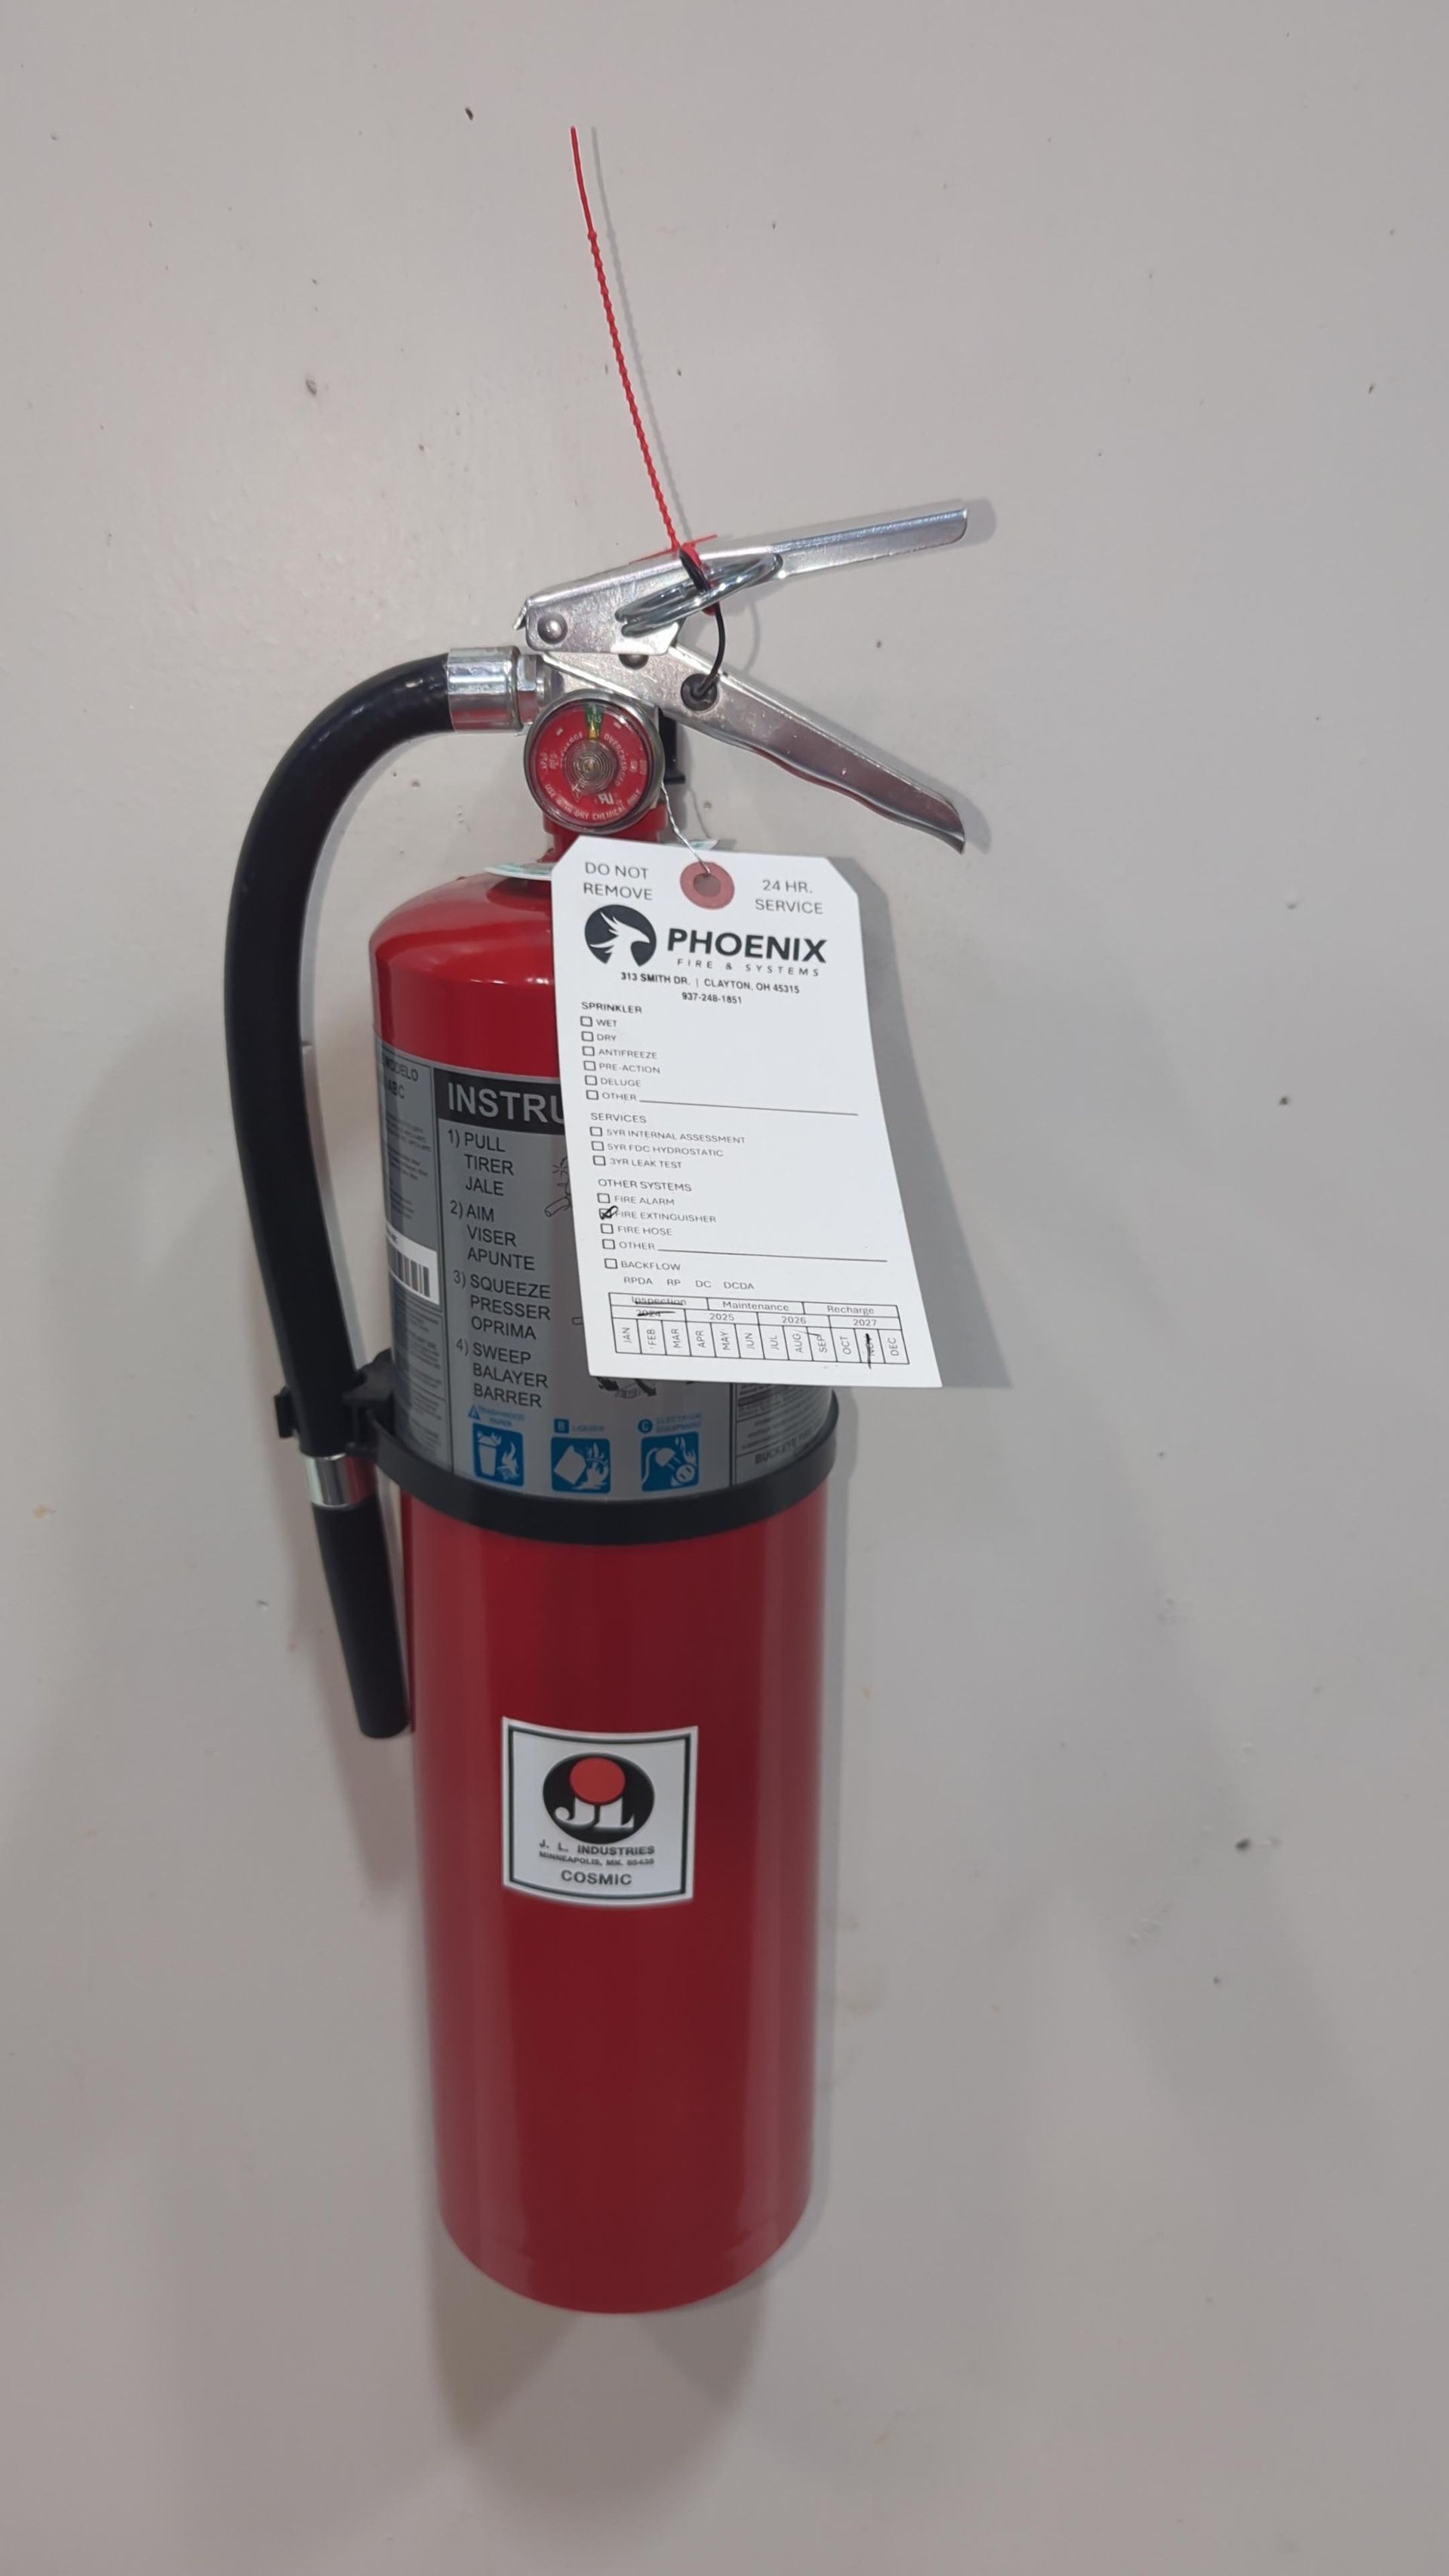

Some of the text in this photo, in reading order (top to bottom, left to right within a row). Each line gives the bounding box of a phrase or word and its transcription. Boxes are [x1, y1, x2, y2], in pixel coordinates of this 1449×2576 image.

[544, 783, 557, 797] USE
[574, 808, 589, 820] DRY
[592, 805, 626, 820] CHEMICAL
[585, 861, 648, 879] DO NOT
[583, 882, 653, 900] REMOVE
[762, 879, 813, 894] 24 HR.
[755, 898, 823, 914] SERVICE
[667, 928, 828, 964] PHOENIX
[677, 959, 712, 969] FIRE
[746, 964, 820, 977] SYSTEMS
[621, 972, 638, 981] 313
[640, 973, 671, 983] SMITH
[674, 976, 691, 985] DR.
[756, 983, 771, 992] OH
[773, 983, 800, 994] 45315
[681, 992, 743, 1005] 937-248-1851
[581, 1002, 642, 1014] SPRINKLER
[596, 1019, 617, 1028] WET
[596, 1033, 617, 1042] DRY
[598, 1048, 658, 1060] ANTIFREEZE
[598, 1063, 661, 1074] PRE-ACTION
[600, 1077, 641, 1087] DELUGE
[601, 1092, 637, 1101] OTHER
[590, 1112, 647, 1124] SERVICES
[448, 1128, 460, 1148] 1)
[464, 1132, 506, 1153] PULL
[606, 1128, 746, 1144] 5YR INTERNAL ASSESSMENT
[607, 1143, 724, 1157] 5YR FDC HYDROSTATIC
[464, 1154, 514, 1176] TIRER
[632, 1159, 656, 1168] LEAK
[660, 1161, 682, 1169] TEST
[465, 1177, 504, 1196] JALE
[598, 1178, 692, 1192] OTHER SYSTEMS
[614, 1195, 675, 1205] FIRE ALARM
[450, 1200, 494, 1223] 2) AIM
[615, 1210, 717, 1223] FIRE EXTINGUISHER
[467, 1225, 517, 1248] VISER
[617, 1225, 673, 1236] FIRE HOSE
[619, 1241, 656, 1250] OTHER
[467, 1247, 535, 1271] APUNTE
[620, 1260, 681, 1271] BACKFLOW
[452, 1270, 552, 1300] 3) SQUEEZE
[623, 1276, 654, 1285] RPDA
[724, 1282, 755, 1290] DCDA
[470, 1294, 551, 1321] PRESSER
[632, 1296, 875, 1316] Inspection Maintenance Recharge
[471, 1316, 537, 1340] OPRIMA
[709, 1313, 734, 1321] 2025
[781, 1316, 807, 1325] 2026
[853, 1319, 877, 1327] 2027
[622, 1327, 632, 1343] JAN
[646, 1328, 657, 1346] FEB
[671, 1328, 681, 1349] MAR
[695, 1330, 706, 1348] APR
[720, 1331, 731, 1351] MAY
[745, 1332, 755, 1350] JUN
[771, 1334, 780, 1350] JUL
[792, 1333, 804, 1353] AUG
[816, 1334, 828, 1353] SEP
[456, 1338, 469, 1356] 4)
[472, 1342, 531, 1365] SWEEP
[840, 1336, 852, 1355] OCT
[888, 1337, 900, 1356] DEC
[473, 1362, 549, 1388] BALAYER
[473, 1382, 543, 1408] BARRER
[539, 1839, 655, 1855] J. L. INDUSTRIES
[539, 1851, 603, 1867] MINNEAPOLIS,
[561, 1869, 632, 1886] COSMIC
